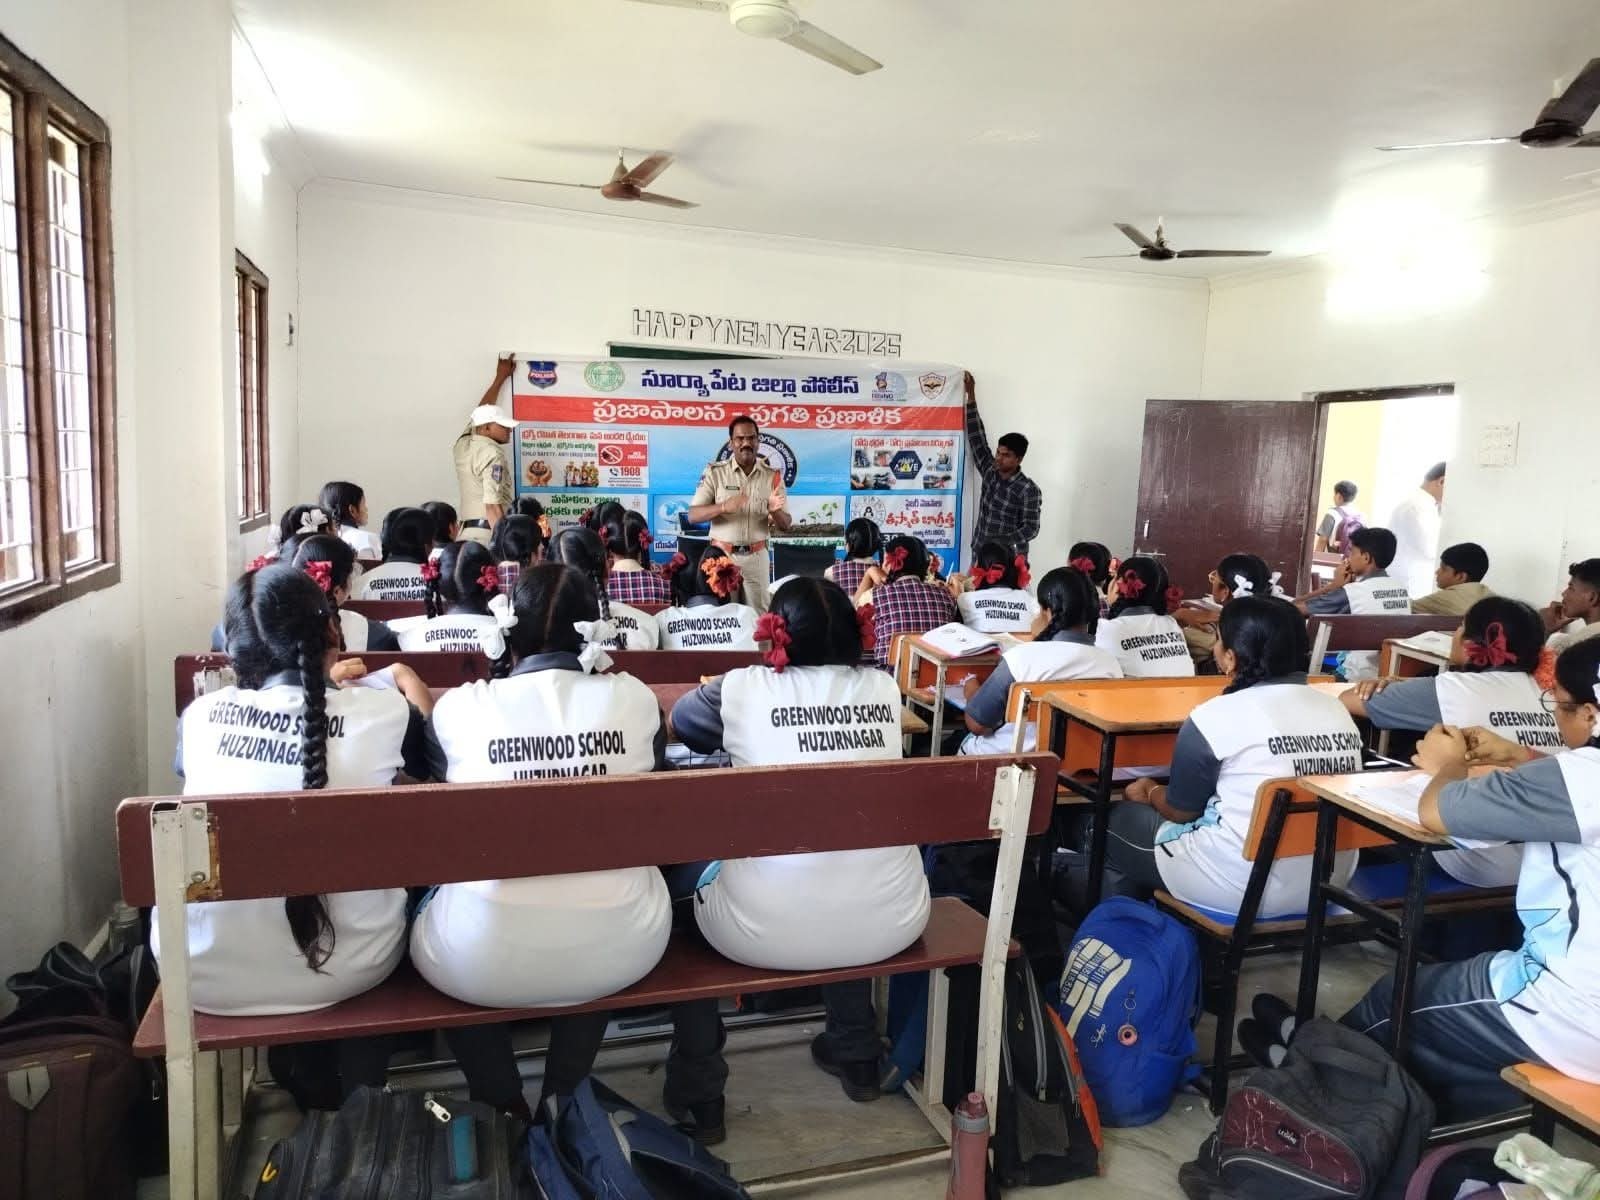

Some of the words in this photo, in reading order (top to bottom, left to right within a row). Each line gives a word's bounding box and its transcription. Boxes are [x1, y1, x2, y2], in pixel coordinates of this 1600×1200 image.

[641, 368, 747, 397] సూర్యాపేట
[751, 376, 797, 397] జిల్లా
[801, 374, 859, 394] పోలీస్
[592, 399, 726, 424] ప్రజాపాలన
[750, 404, 810, 428] ప్రగతి
[815, 405, 902, 429] ప్రణాళిక
[620, 466, 641, 477] 1908
[369, 578, 410, 591] GREENWOOD
[974, 599, 1007, 609] GREENWOOD
[1007, 602, 1028, 611] SCHOOL
[984, 609, 1020, 620] HUZURNAGAR
[667, 619, 712, 634] GREENWOOD
[713, 617, 741, 630] SCHOOL
[681, 631, 733, 648] HUZURNAGAR
[1120, 633, 1168, 651] GREENWOOD
[208, 701, 291, 734] GREENWOOD
[770, 705, 852, 728] GREENWOOD
[853, 703, 895, 724] SCHOOL
[1489, 711, 1555, 727] GREENWOOD
[216, 733, 304, 766] HUZURNAGA
[488, 734, 575, 764] GREENWOOD
[577, 730, 626, 757] SCHOOL
[797, 728, 886, 753] HUZURNAGAR
[1268, 734, 1333, 755] GREENWOOD
[1292, 756, 1356, 777] HUZURNAGAR
